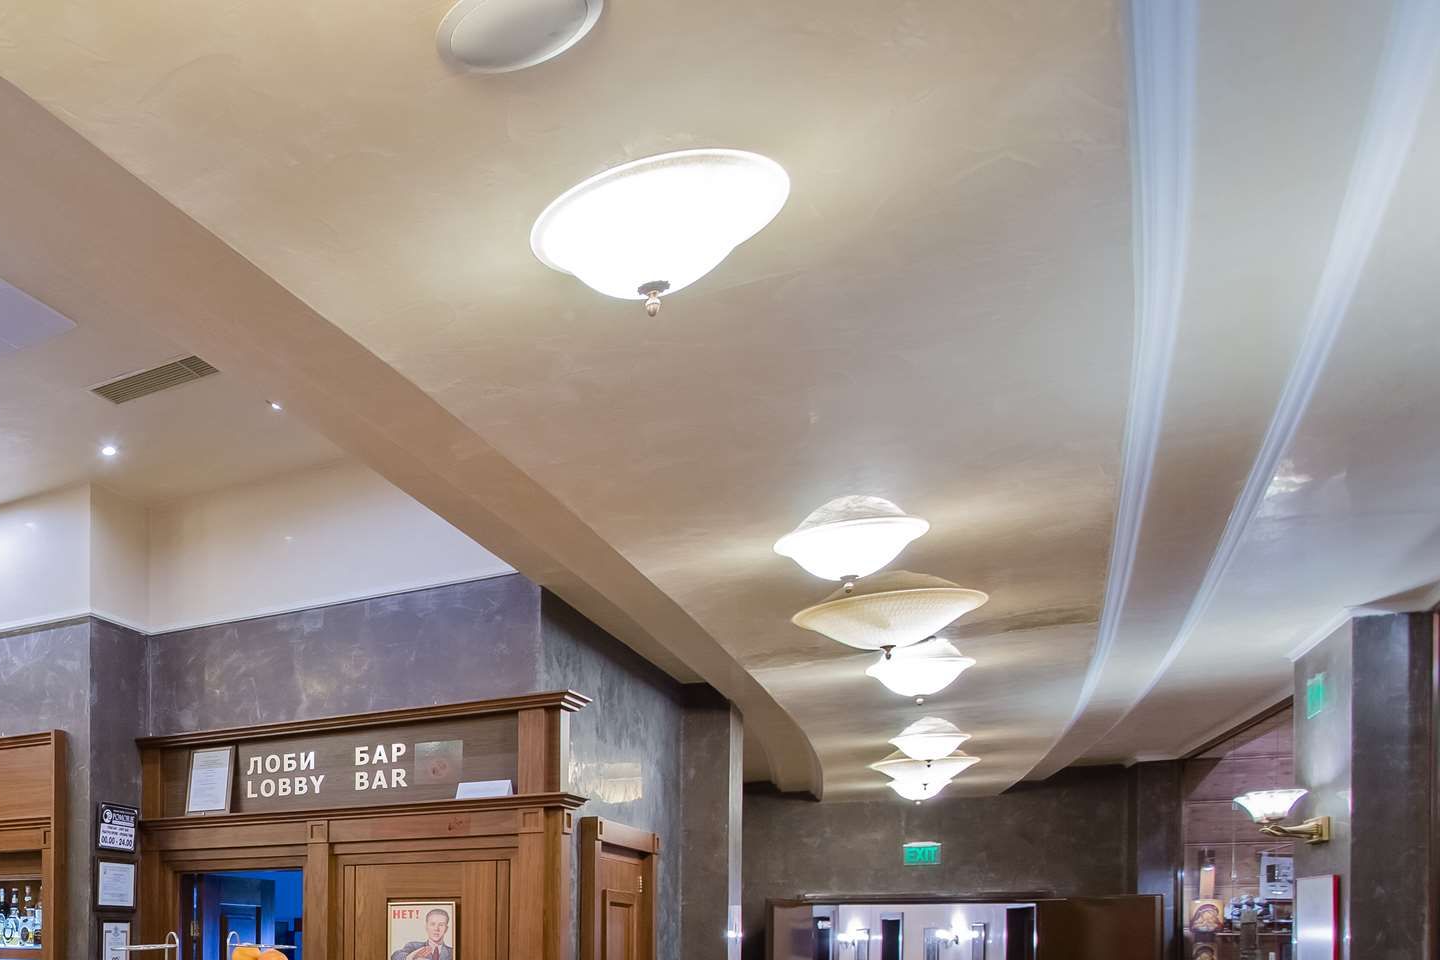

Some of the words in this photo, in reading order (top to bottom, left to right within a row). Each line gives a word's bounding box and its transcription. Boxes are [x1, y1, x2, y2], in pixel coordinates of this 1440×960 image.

[247, 752, 315, 775] ЛОБИ
[355, 743, 406, 766] БАР
[247, 775, 325, 799] LOBBY
[355, 768, 408, 791] BAR
[906, 847, 938, 862] EXIT
[393, 910, 419, 919] НЕТ!
